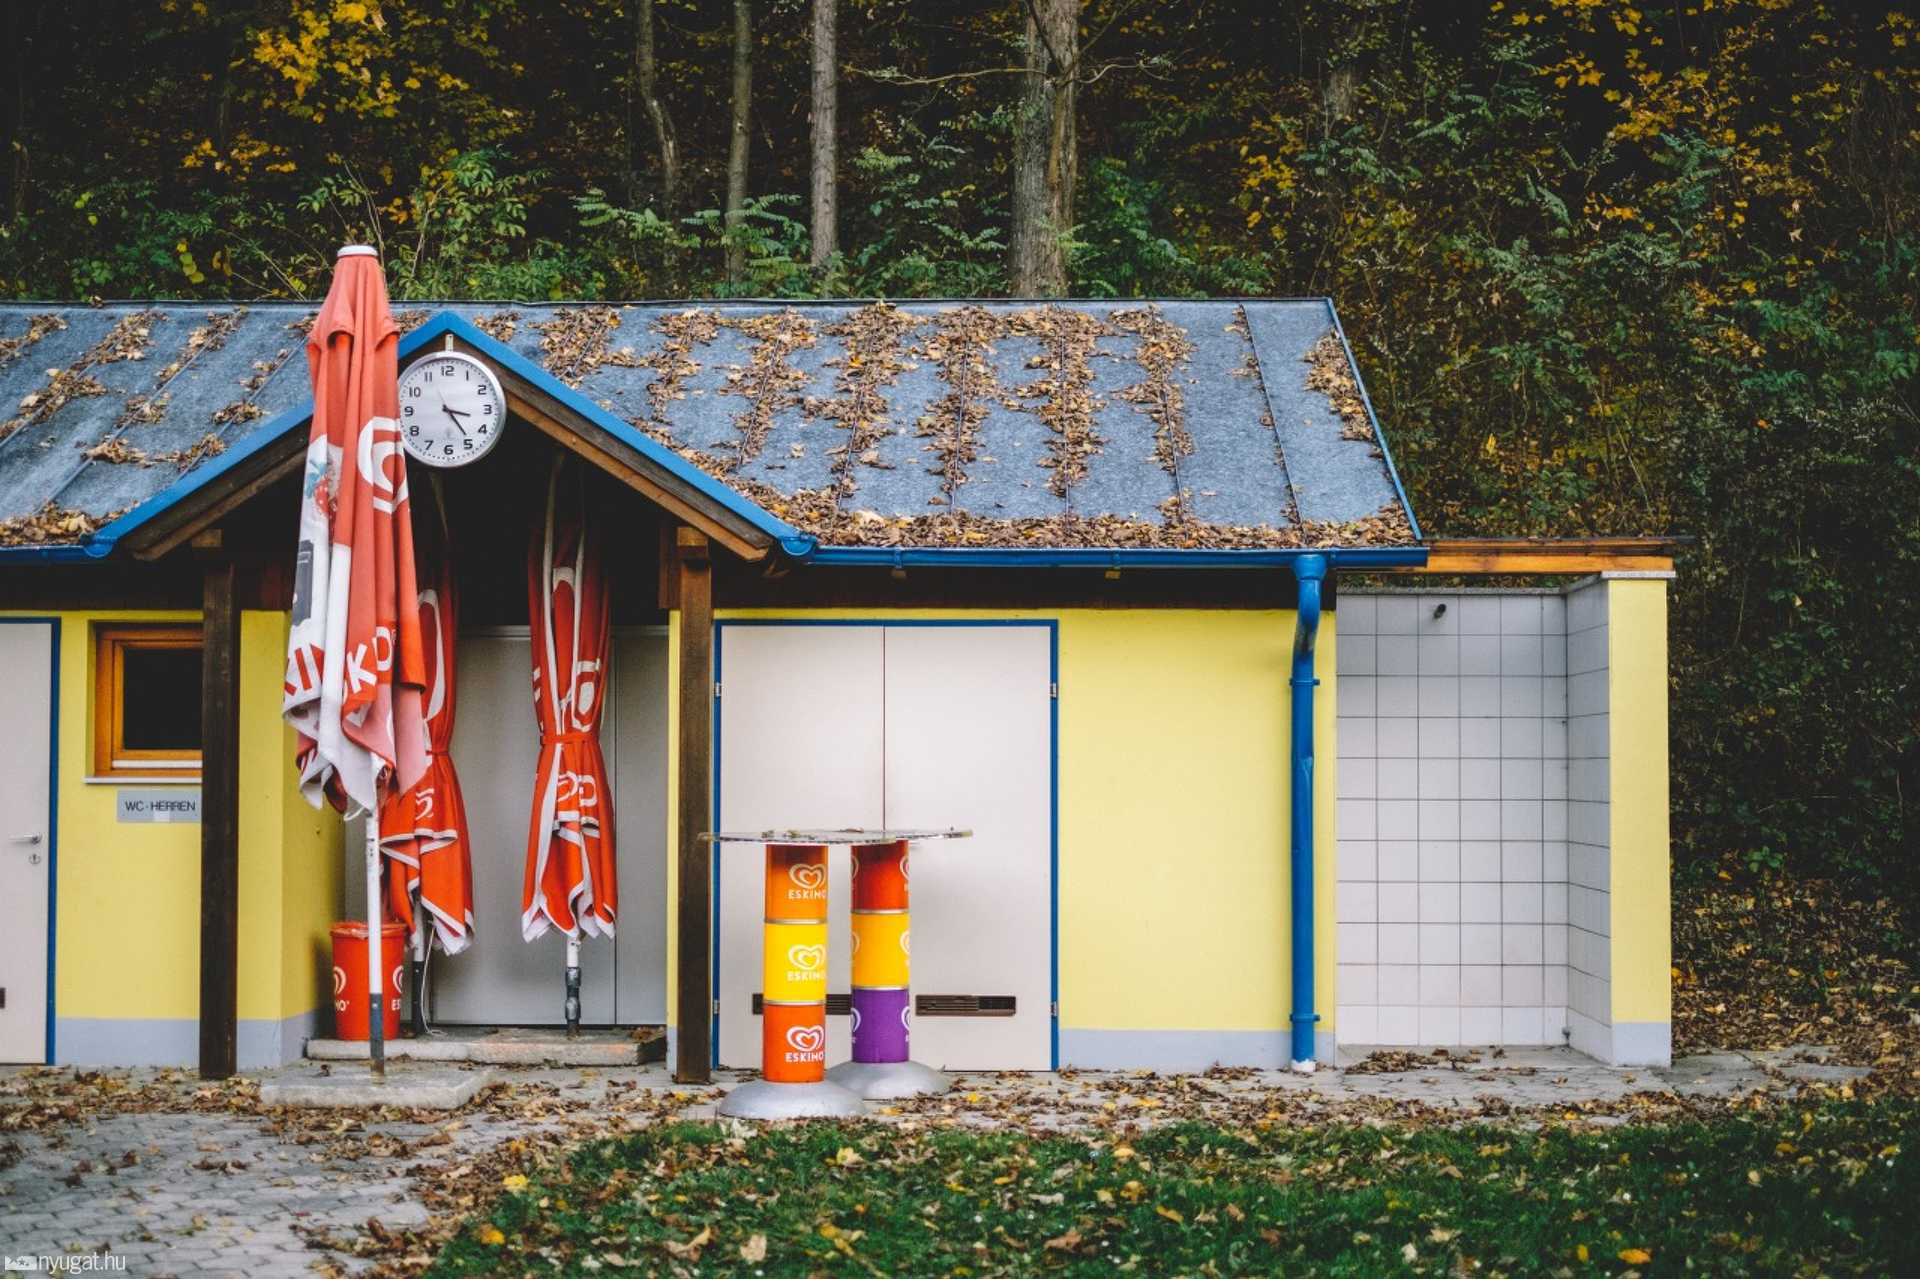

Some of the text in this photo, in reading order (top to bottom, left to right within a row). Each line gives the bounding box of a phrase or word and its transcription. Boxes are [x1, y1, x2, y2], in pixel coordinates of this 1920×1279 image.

[441, 365, 455, 376] 12
[425, 371, 433, 382] 11
[409, 386, 421, 397] 10
[478, 384, 487, 395] 2
[404, 406, 414, 417] 9
[483, 404, 492, 415] 3
[410, 425, 420, 436] 8
[478, 424, 487, 434] 4
[424, 440, 434, 450] 7
[444, 444, 454, 455] 6
[463, 439, 473, 450] 5
